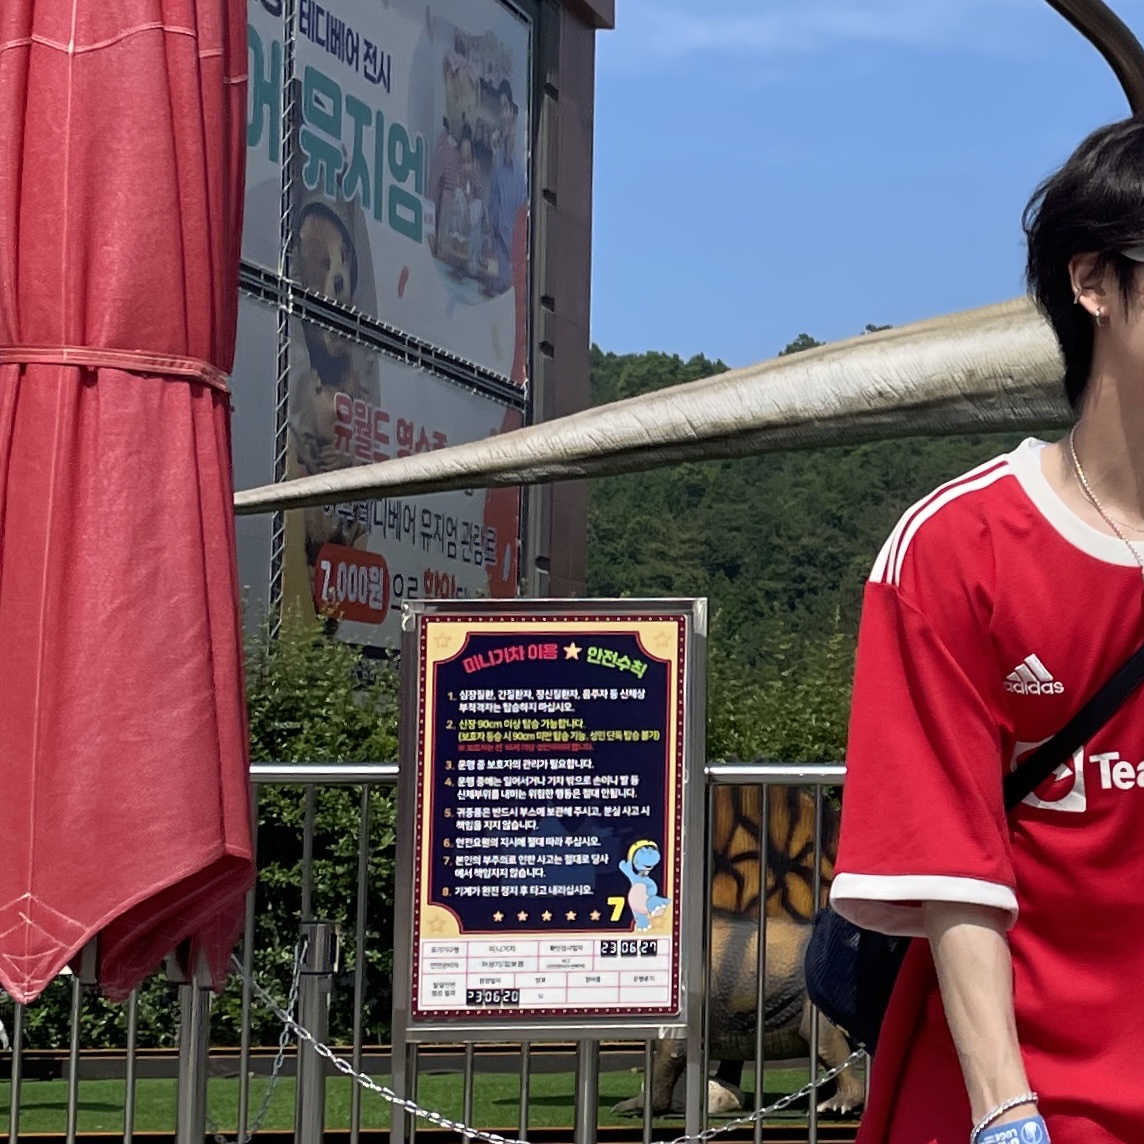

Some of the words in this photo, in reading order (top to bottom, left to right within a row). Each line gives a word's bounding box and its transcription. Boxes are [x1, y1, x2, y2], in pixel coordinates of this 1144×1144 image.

[300, 0, 359, 72] 테디베어
[363, 38, 391, 94] 전시
[301, 65, 423, 244] 뮤지엄
[420, 508, 457, 559] 뮤지엄
[462, 645, 524, 673] 미니기차
[528, 644, 558, 660] 이용
[587, 647, 648, 679] 안전수칙
[1004, 679, 1064, 695] adidas
[477, 720, 502, 729] 90cm
[504, 720, 520, 729] 이상
[487, 759, 521, 770] 보호자의
[484, 820, 500, 830] 지지
[607, 897, 625, 921] 7
[601, 942, 616, 953] 23
[621, 942, 636, 953] 06
[485, 991, 500, 1003] 06
[503, 991, 518, 1002] 20
